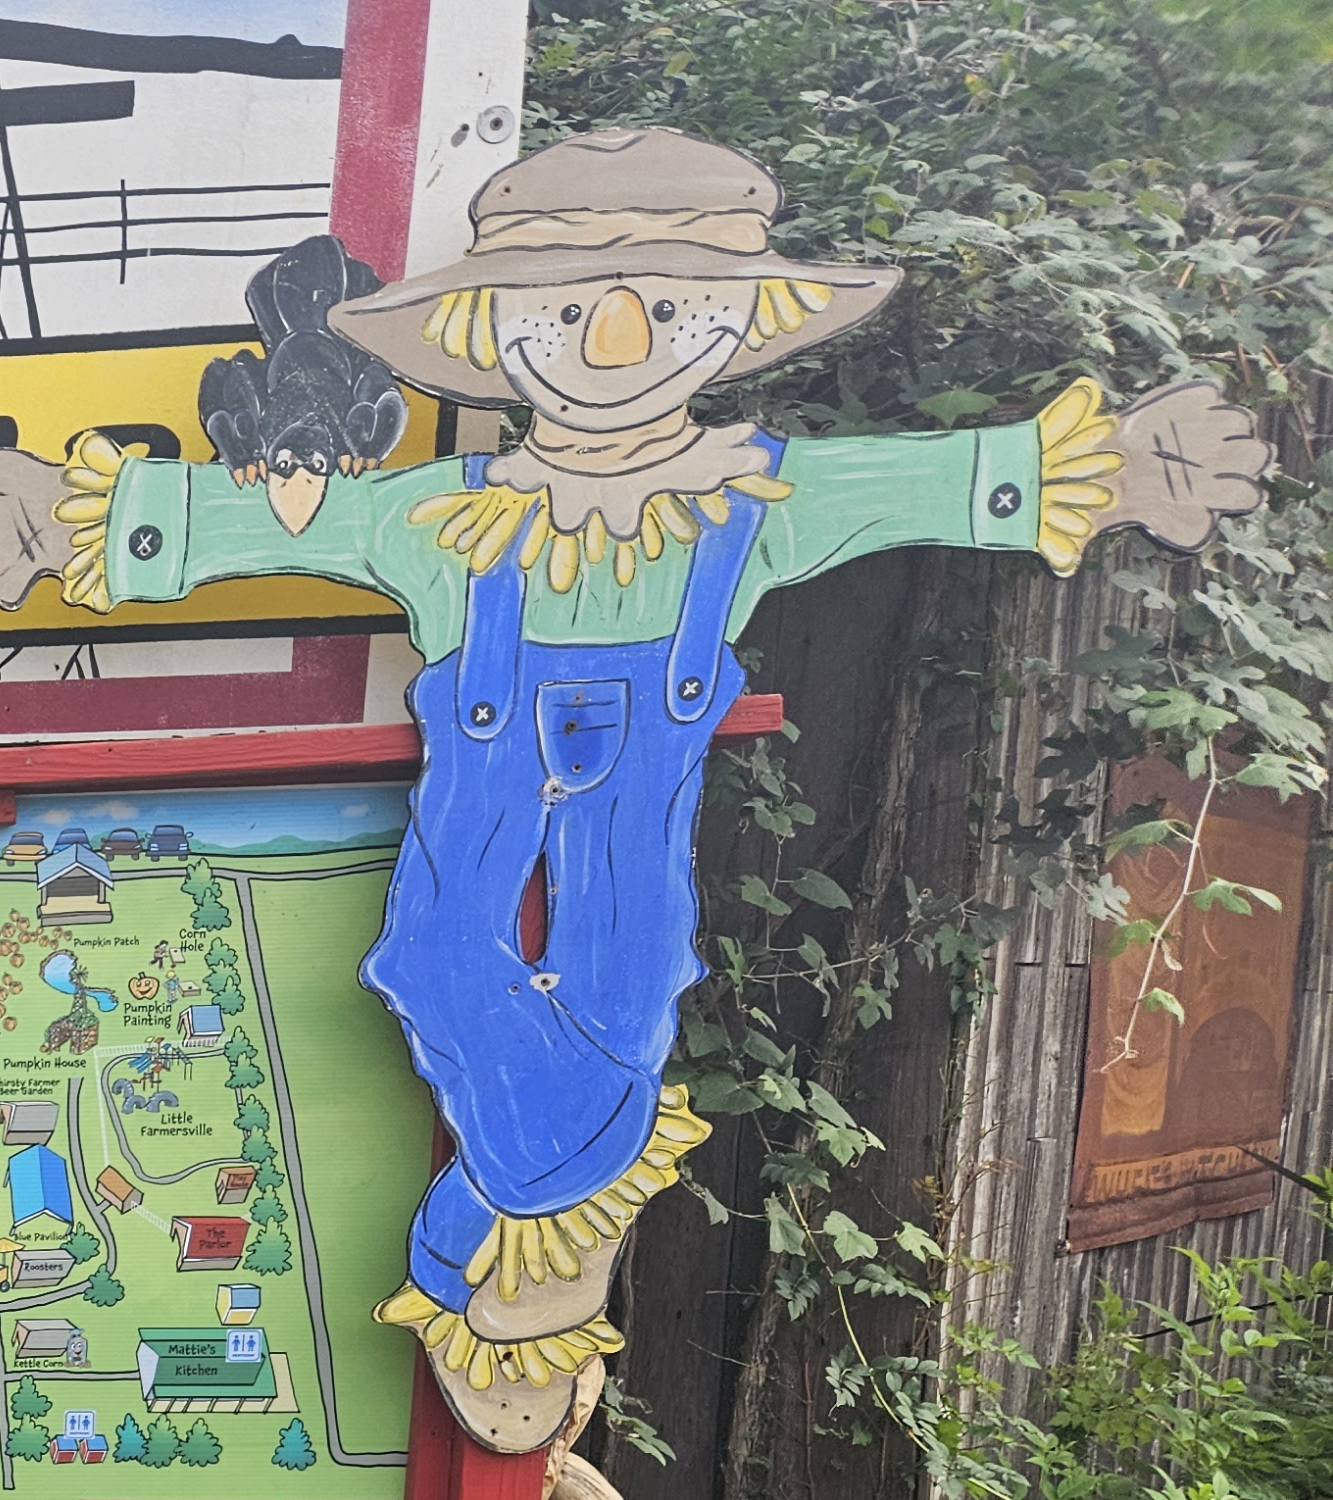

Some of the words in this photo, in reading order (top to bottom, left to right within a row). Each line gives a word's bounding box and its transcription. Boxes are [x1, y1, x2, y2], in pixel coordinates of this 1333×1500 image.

[179, 929, 205, 939] Corn
[74, 937, 111, 948] Pumpkin
[114, 937, 140, 946] Patch
[180, 940, 204, 952] Hole
[124, 1003, 172, 1015] Pumpkin
[123, 1015, 171, 1028] Painting
[4, 1058, 51, 1070] Pumpkin
[55, 1058, 86, 1069] House
[28, 1078, 60, 1087] Farmer
[161, 1112, 192, 1124] Little
[141, 1124, 212, 1137] Farmersville
[24, 1261, 63, 1272] Roosters
[169, 1343, 216, 1355] Mattie's
[14, 1360, 41, 1368] Kettle
[43, 1360, 63, 1368] Corn
[175, 1365, 218, 1376] Kitchen
